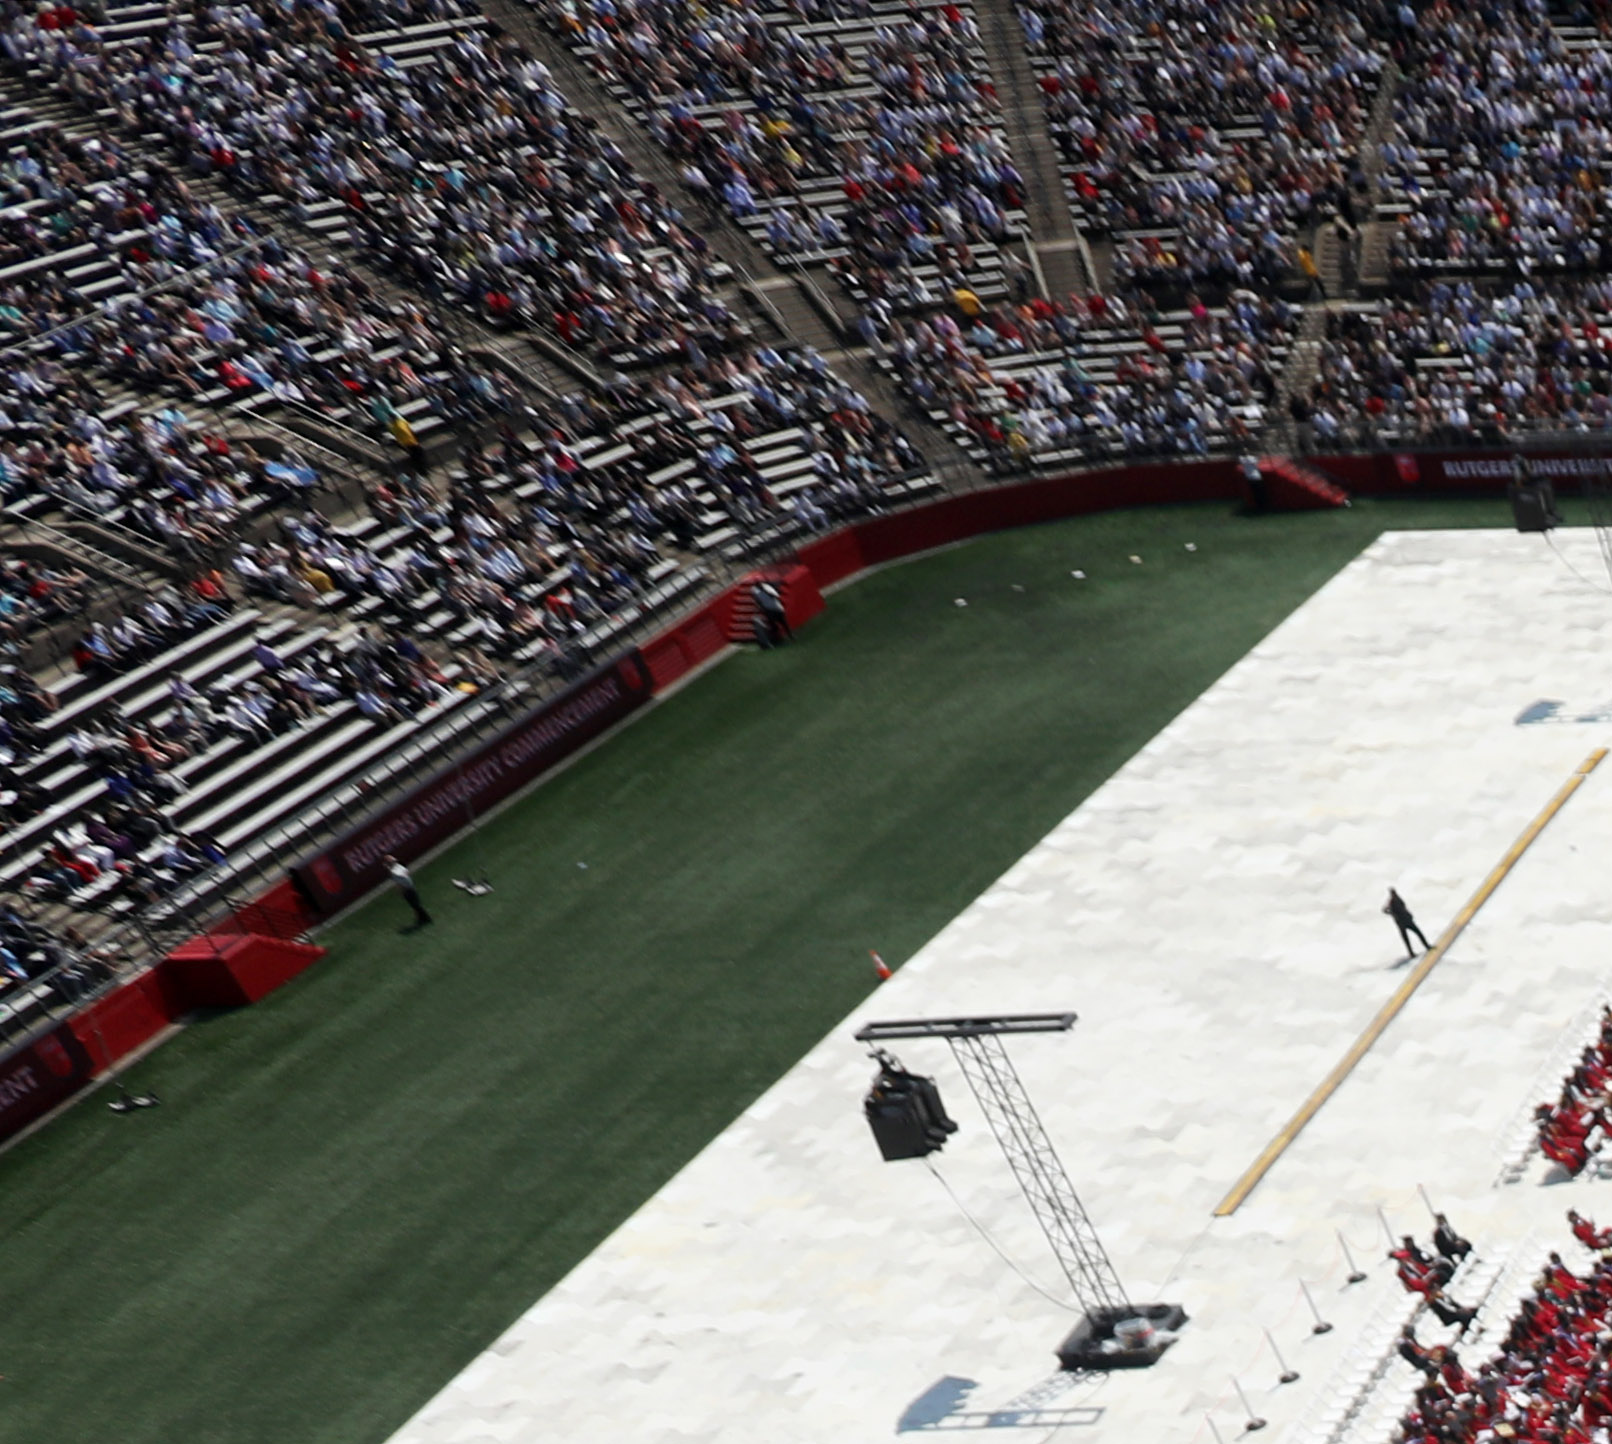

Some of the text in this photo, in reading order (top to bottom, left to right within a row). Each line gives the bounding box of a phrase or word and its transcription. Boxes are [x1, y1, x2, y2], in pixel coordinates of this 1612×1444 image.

[1442, 460, 1519, 477] RUTGERS
[344, 676, 620, 873] RUTGERS UNIVERSITY COMMENCEMENT
